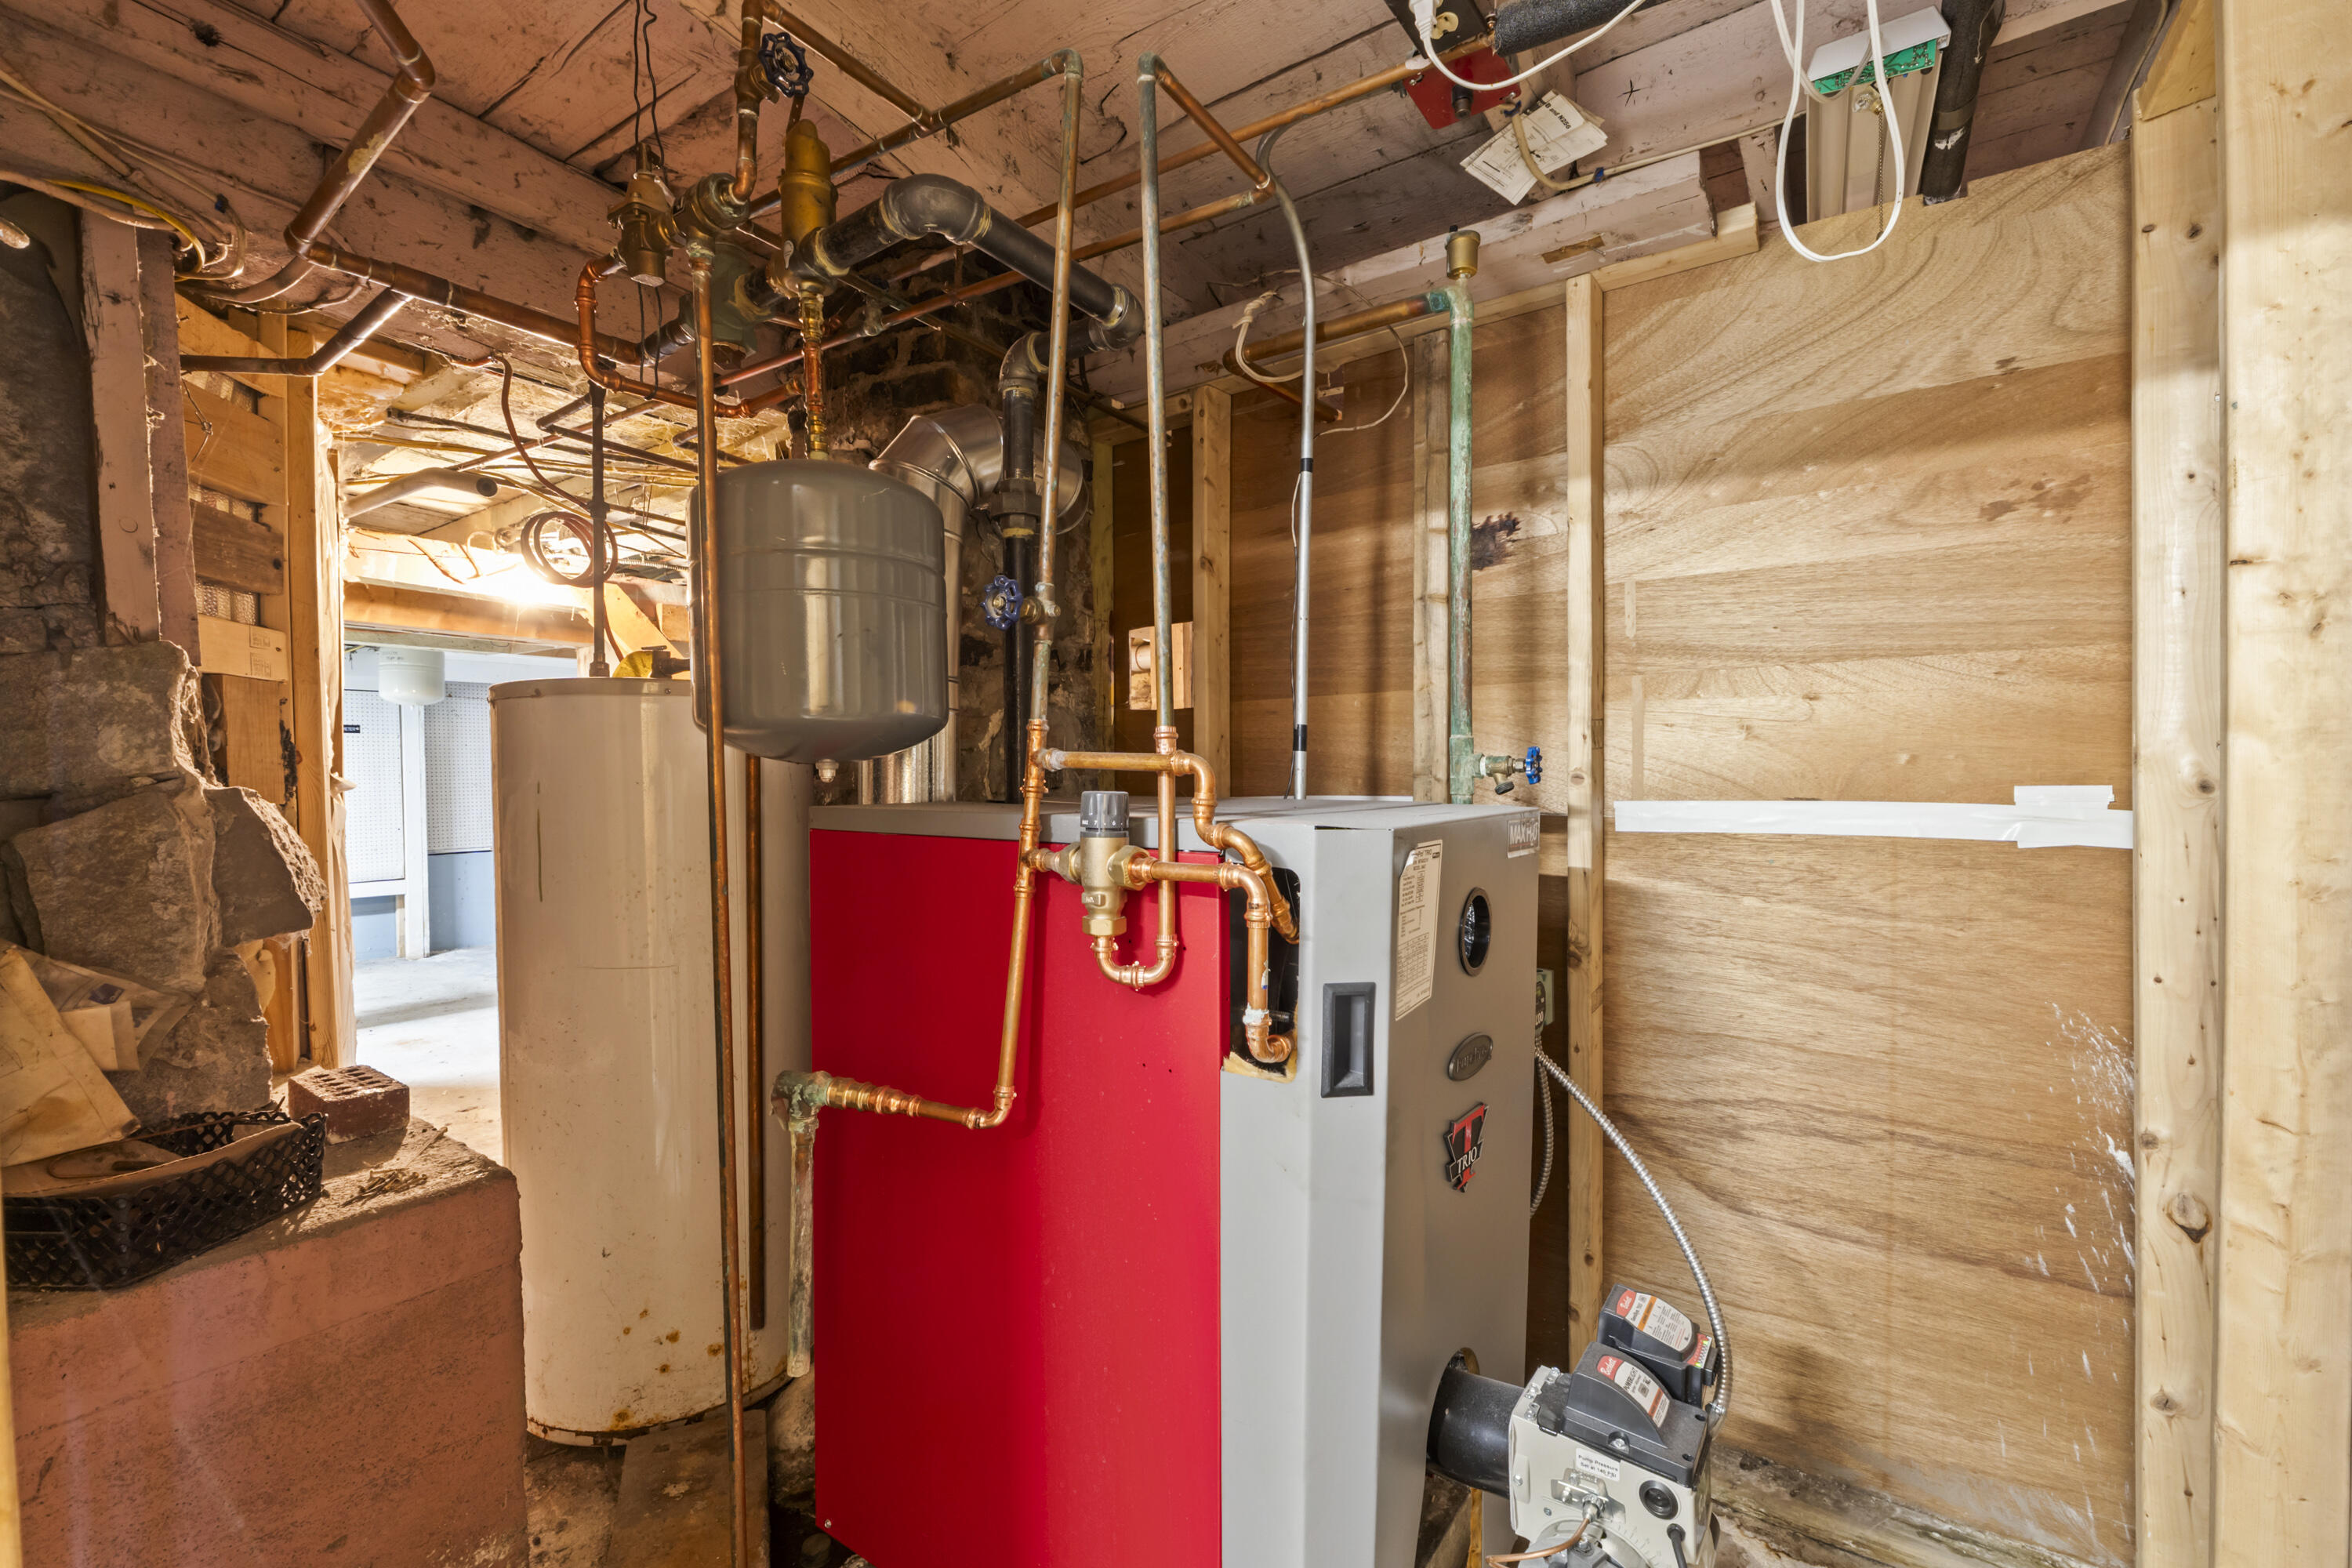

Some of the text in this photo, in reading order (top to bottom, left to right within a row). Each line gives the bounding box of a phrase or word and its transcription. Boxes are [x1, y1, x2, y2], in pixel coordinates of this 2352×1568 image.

[1510, 824, 1526, 844] MAX
[1457, 1146, 1477, 1174] TRIO
[1600, 1356, 1617, 1375] Beckett
[1595, 1460, 1618, 1472] Pressure
